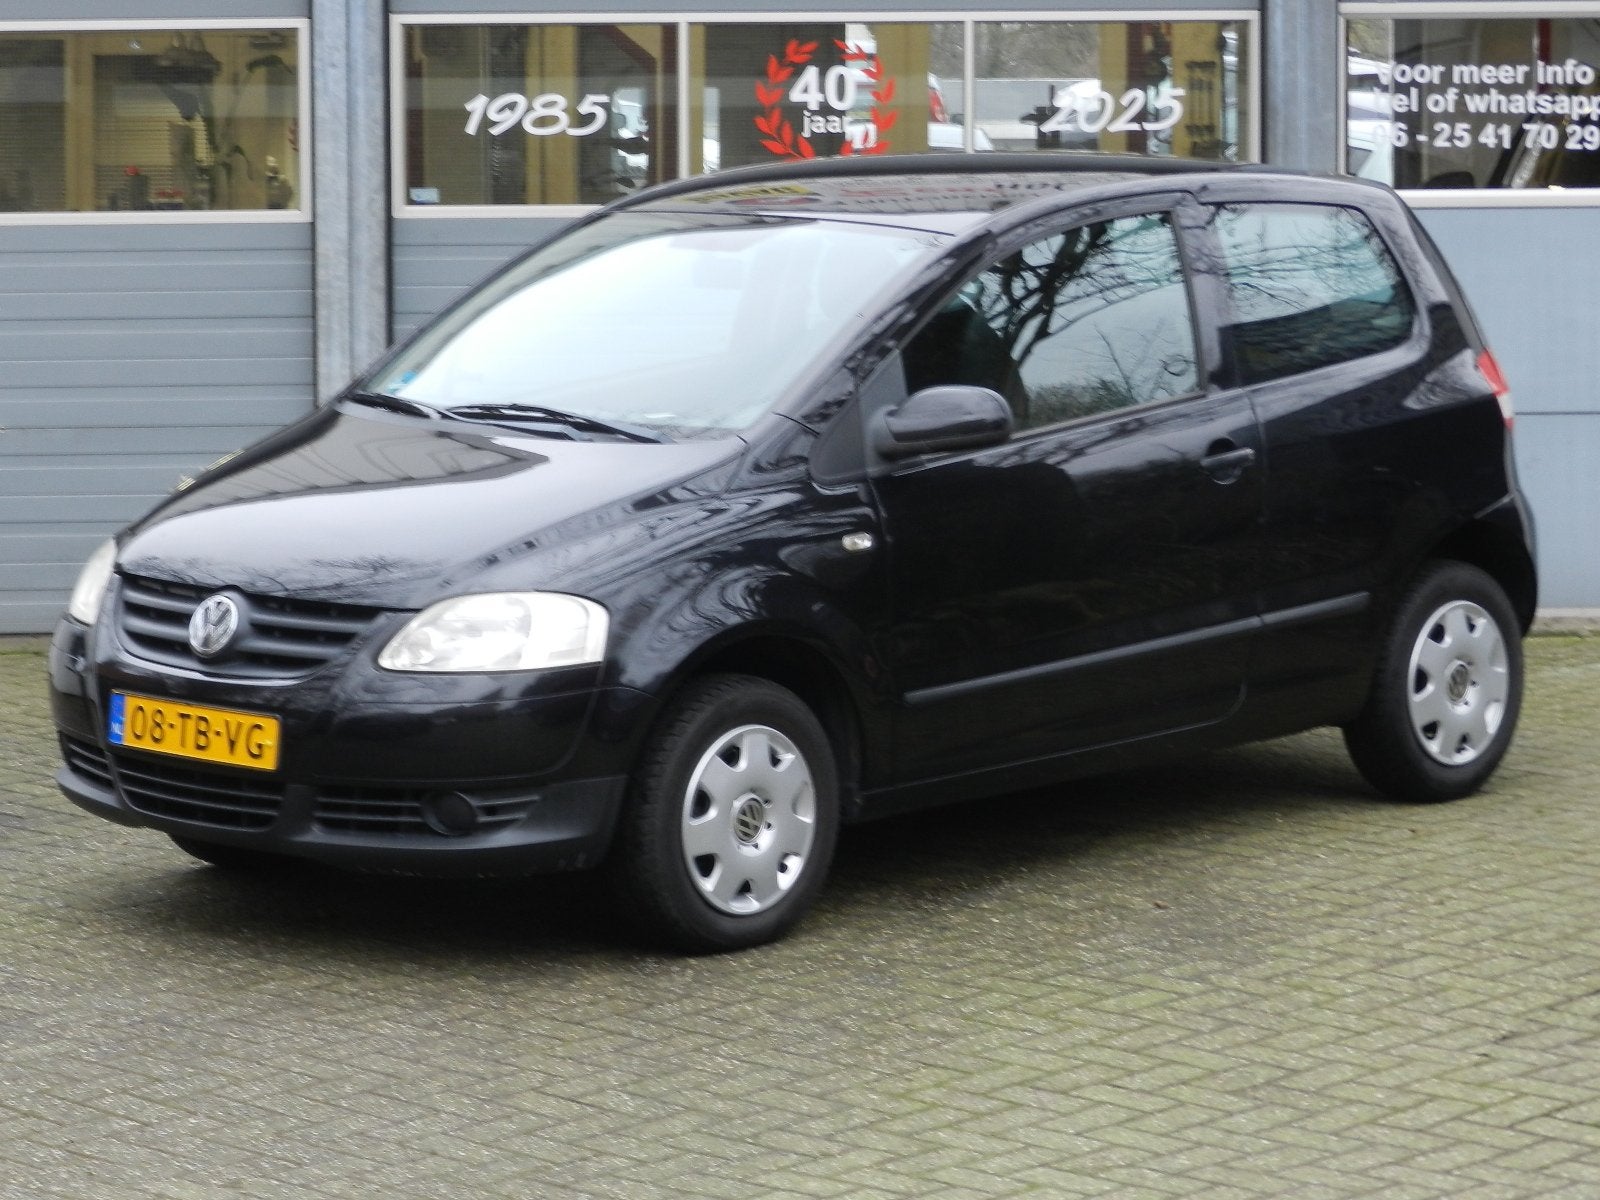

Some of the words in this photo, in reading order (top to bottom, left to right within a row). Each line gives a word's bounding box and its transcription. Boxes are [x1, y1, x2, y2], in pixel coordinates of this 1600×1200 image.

[788, 64, 857, 111] 40
[1376, 60, 1446, 85] Voor
[1452, 63, 1530, 85] meer
[1537, 58, 1595, 85] info
[463, 92, 610, 136] 1985
[1039, 85, 1186, 133] 2025
[1426, 87, 1459, 113] of
[1432, 122, 1472, 149] 25
[1478, 122, 1512, 150] 41
[1521, 122, 1559, 149] 70
[1565, 123, 1600, 150] 29
[130, 704, 266, 760] 08-TB-VG
